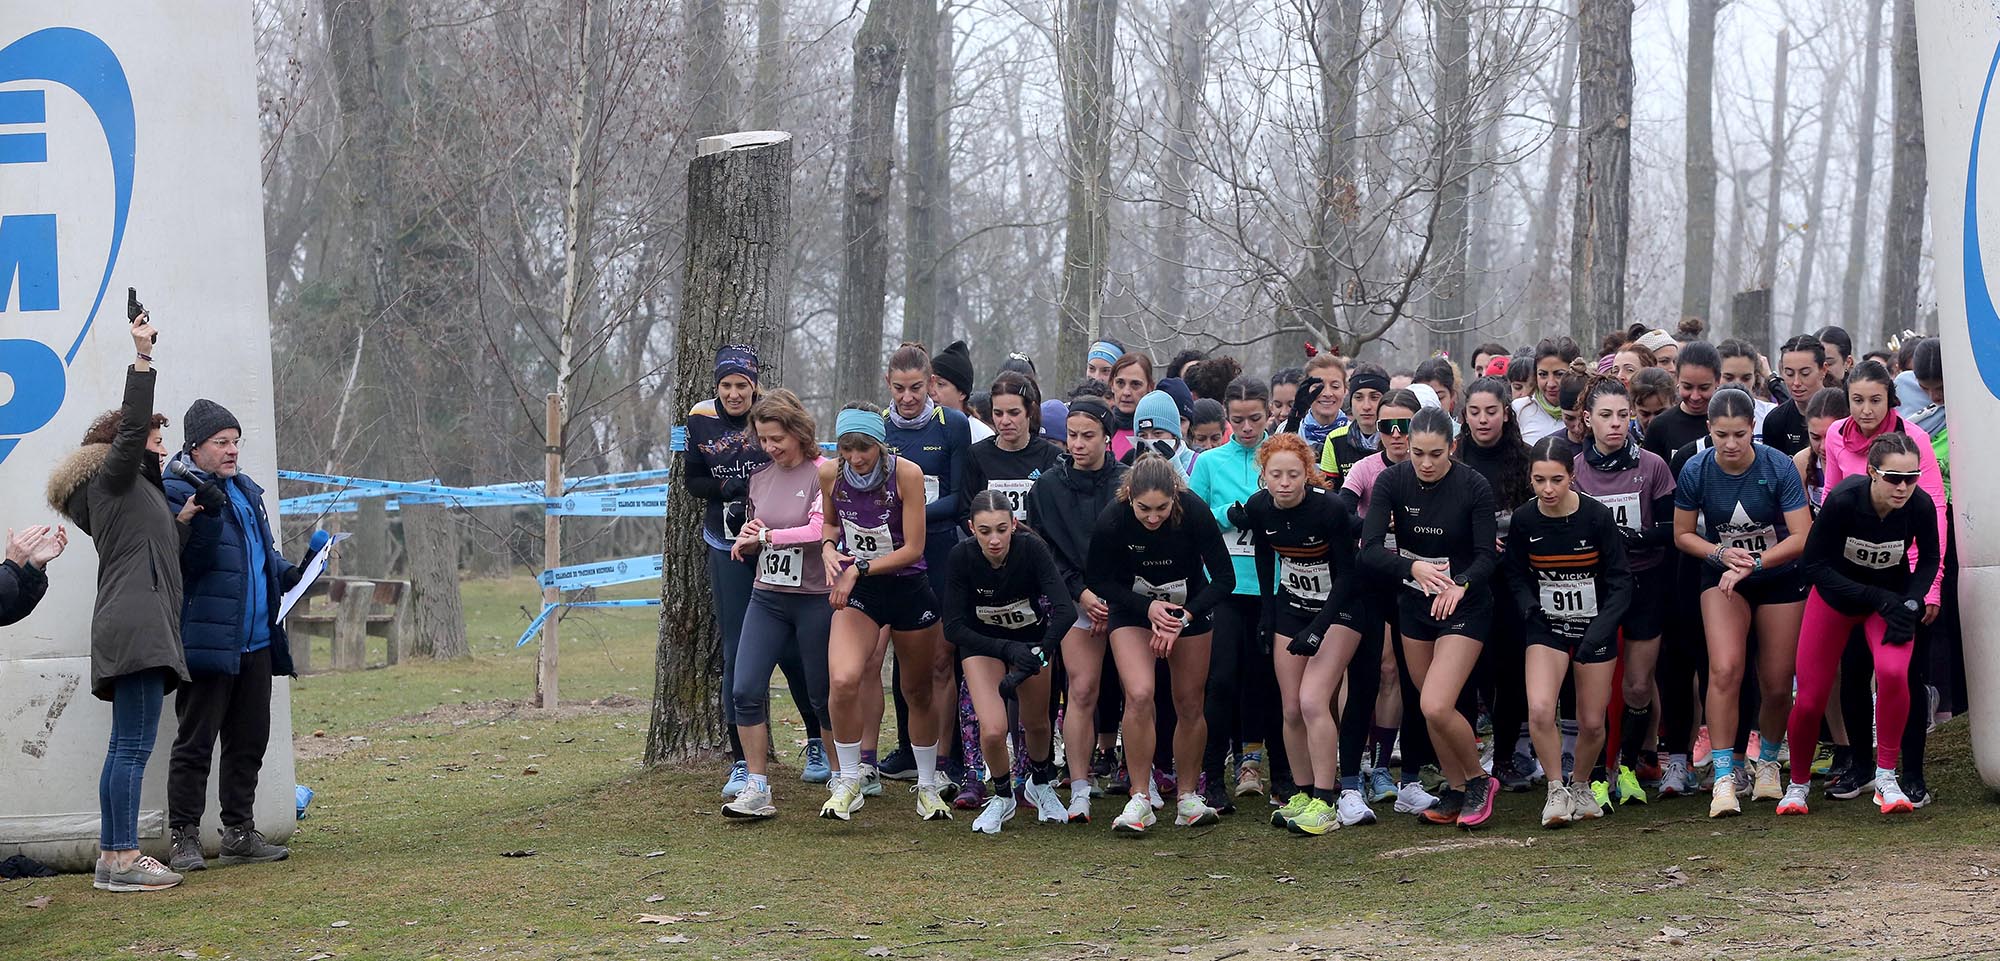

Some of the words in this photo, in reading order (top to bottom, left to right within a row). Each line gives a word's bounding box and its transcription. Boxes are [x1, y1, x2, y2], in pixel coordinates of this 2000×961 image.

[1002, 490, 1028, 511] 31
[1609, 505, 1628, 526] 4
[1413, 525, 1443, 536] OYSHO
[854, 534, 877, 552] 28
[765, 553, 791, 576] 134
[1856, 548, 1891, 564] 913
[1288, 572, 1321, 593] 901
[1558, 572, 1590, 580] VICKY
[1552, 590, 1583, 611] 911
[991, 610, 1025, 625] 916
